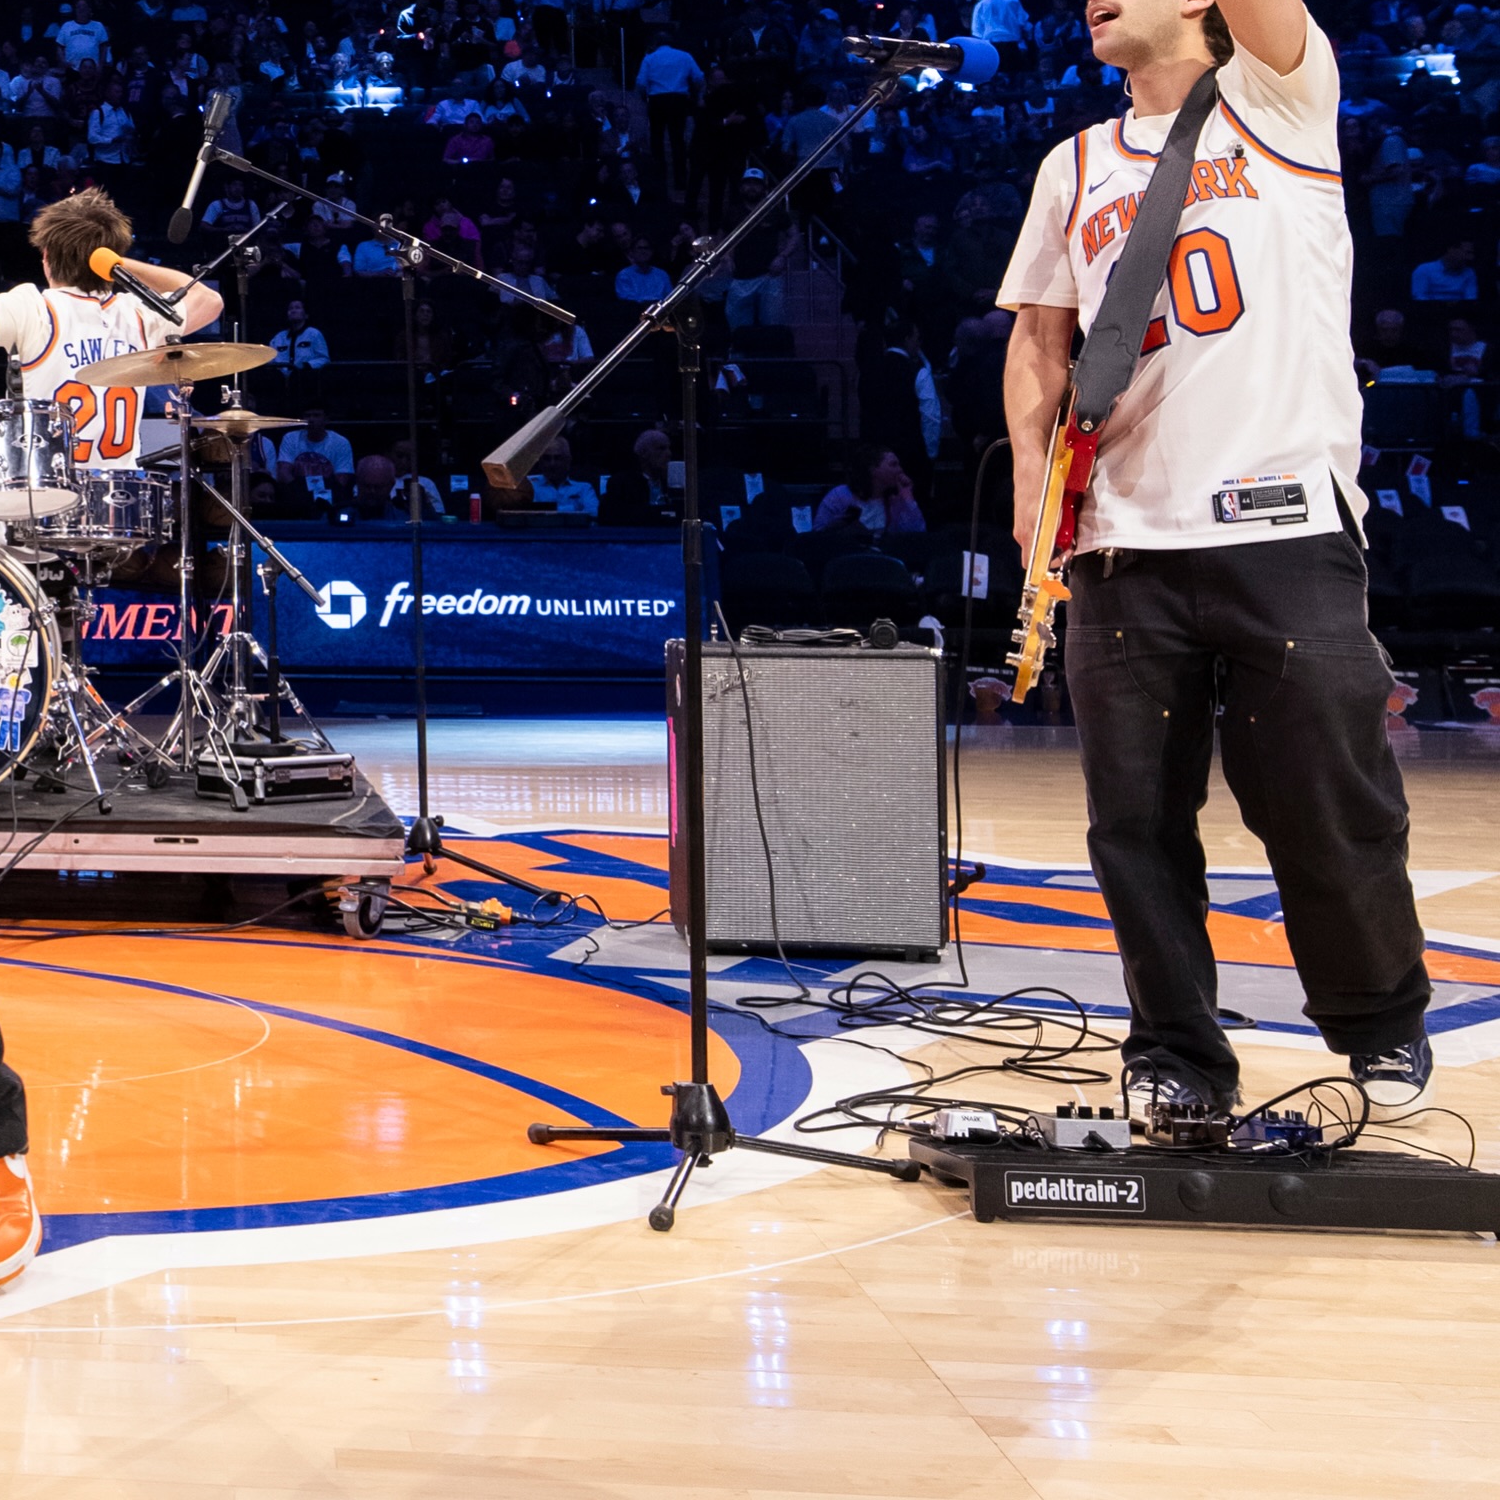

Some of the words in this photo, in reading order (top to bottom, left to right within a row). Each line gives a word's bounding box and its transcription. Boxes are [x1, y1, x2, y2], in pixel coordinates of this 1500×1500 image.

[1136, 226, 1246, 358] 0
[53, 380, 138, 463] 20
[379, 582, 531, 627] freedom
